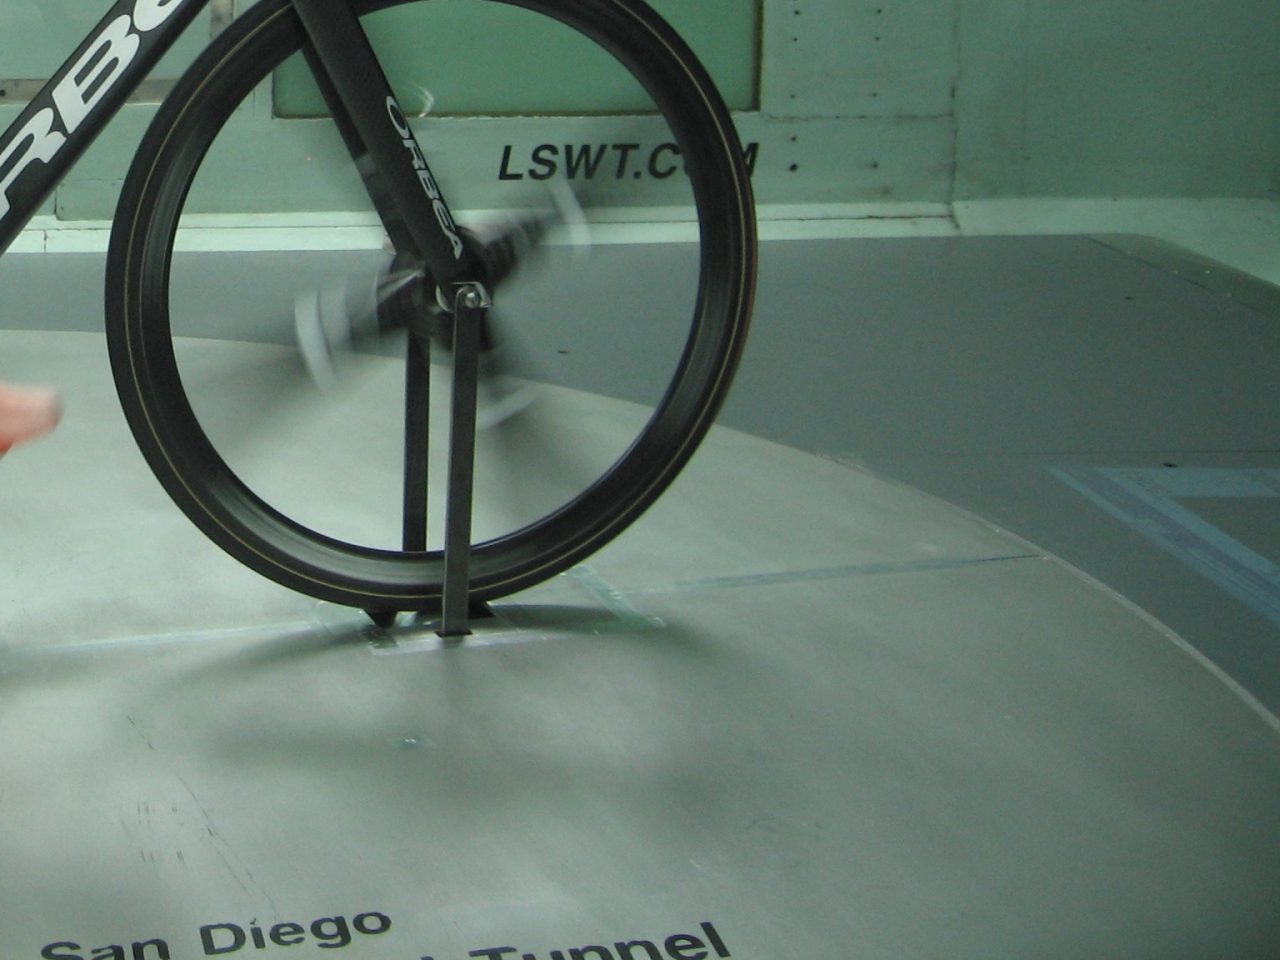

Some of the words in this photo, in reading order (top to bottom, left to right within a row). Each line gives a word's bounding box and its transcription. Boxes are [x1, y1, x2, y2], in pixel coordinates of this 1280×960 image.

[385, 95, 464, 260] ORBEA
[199, 911, 393, 956] Diego
[468, 921, 732, 960] Tnnel
